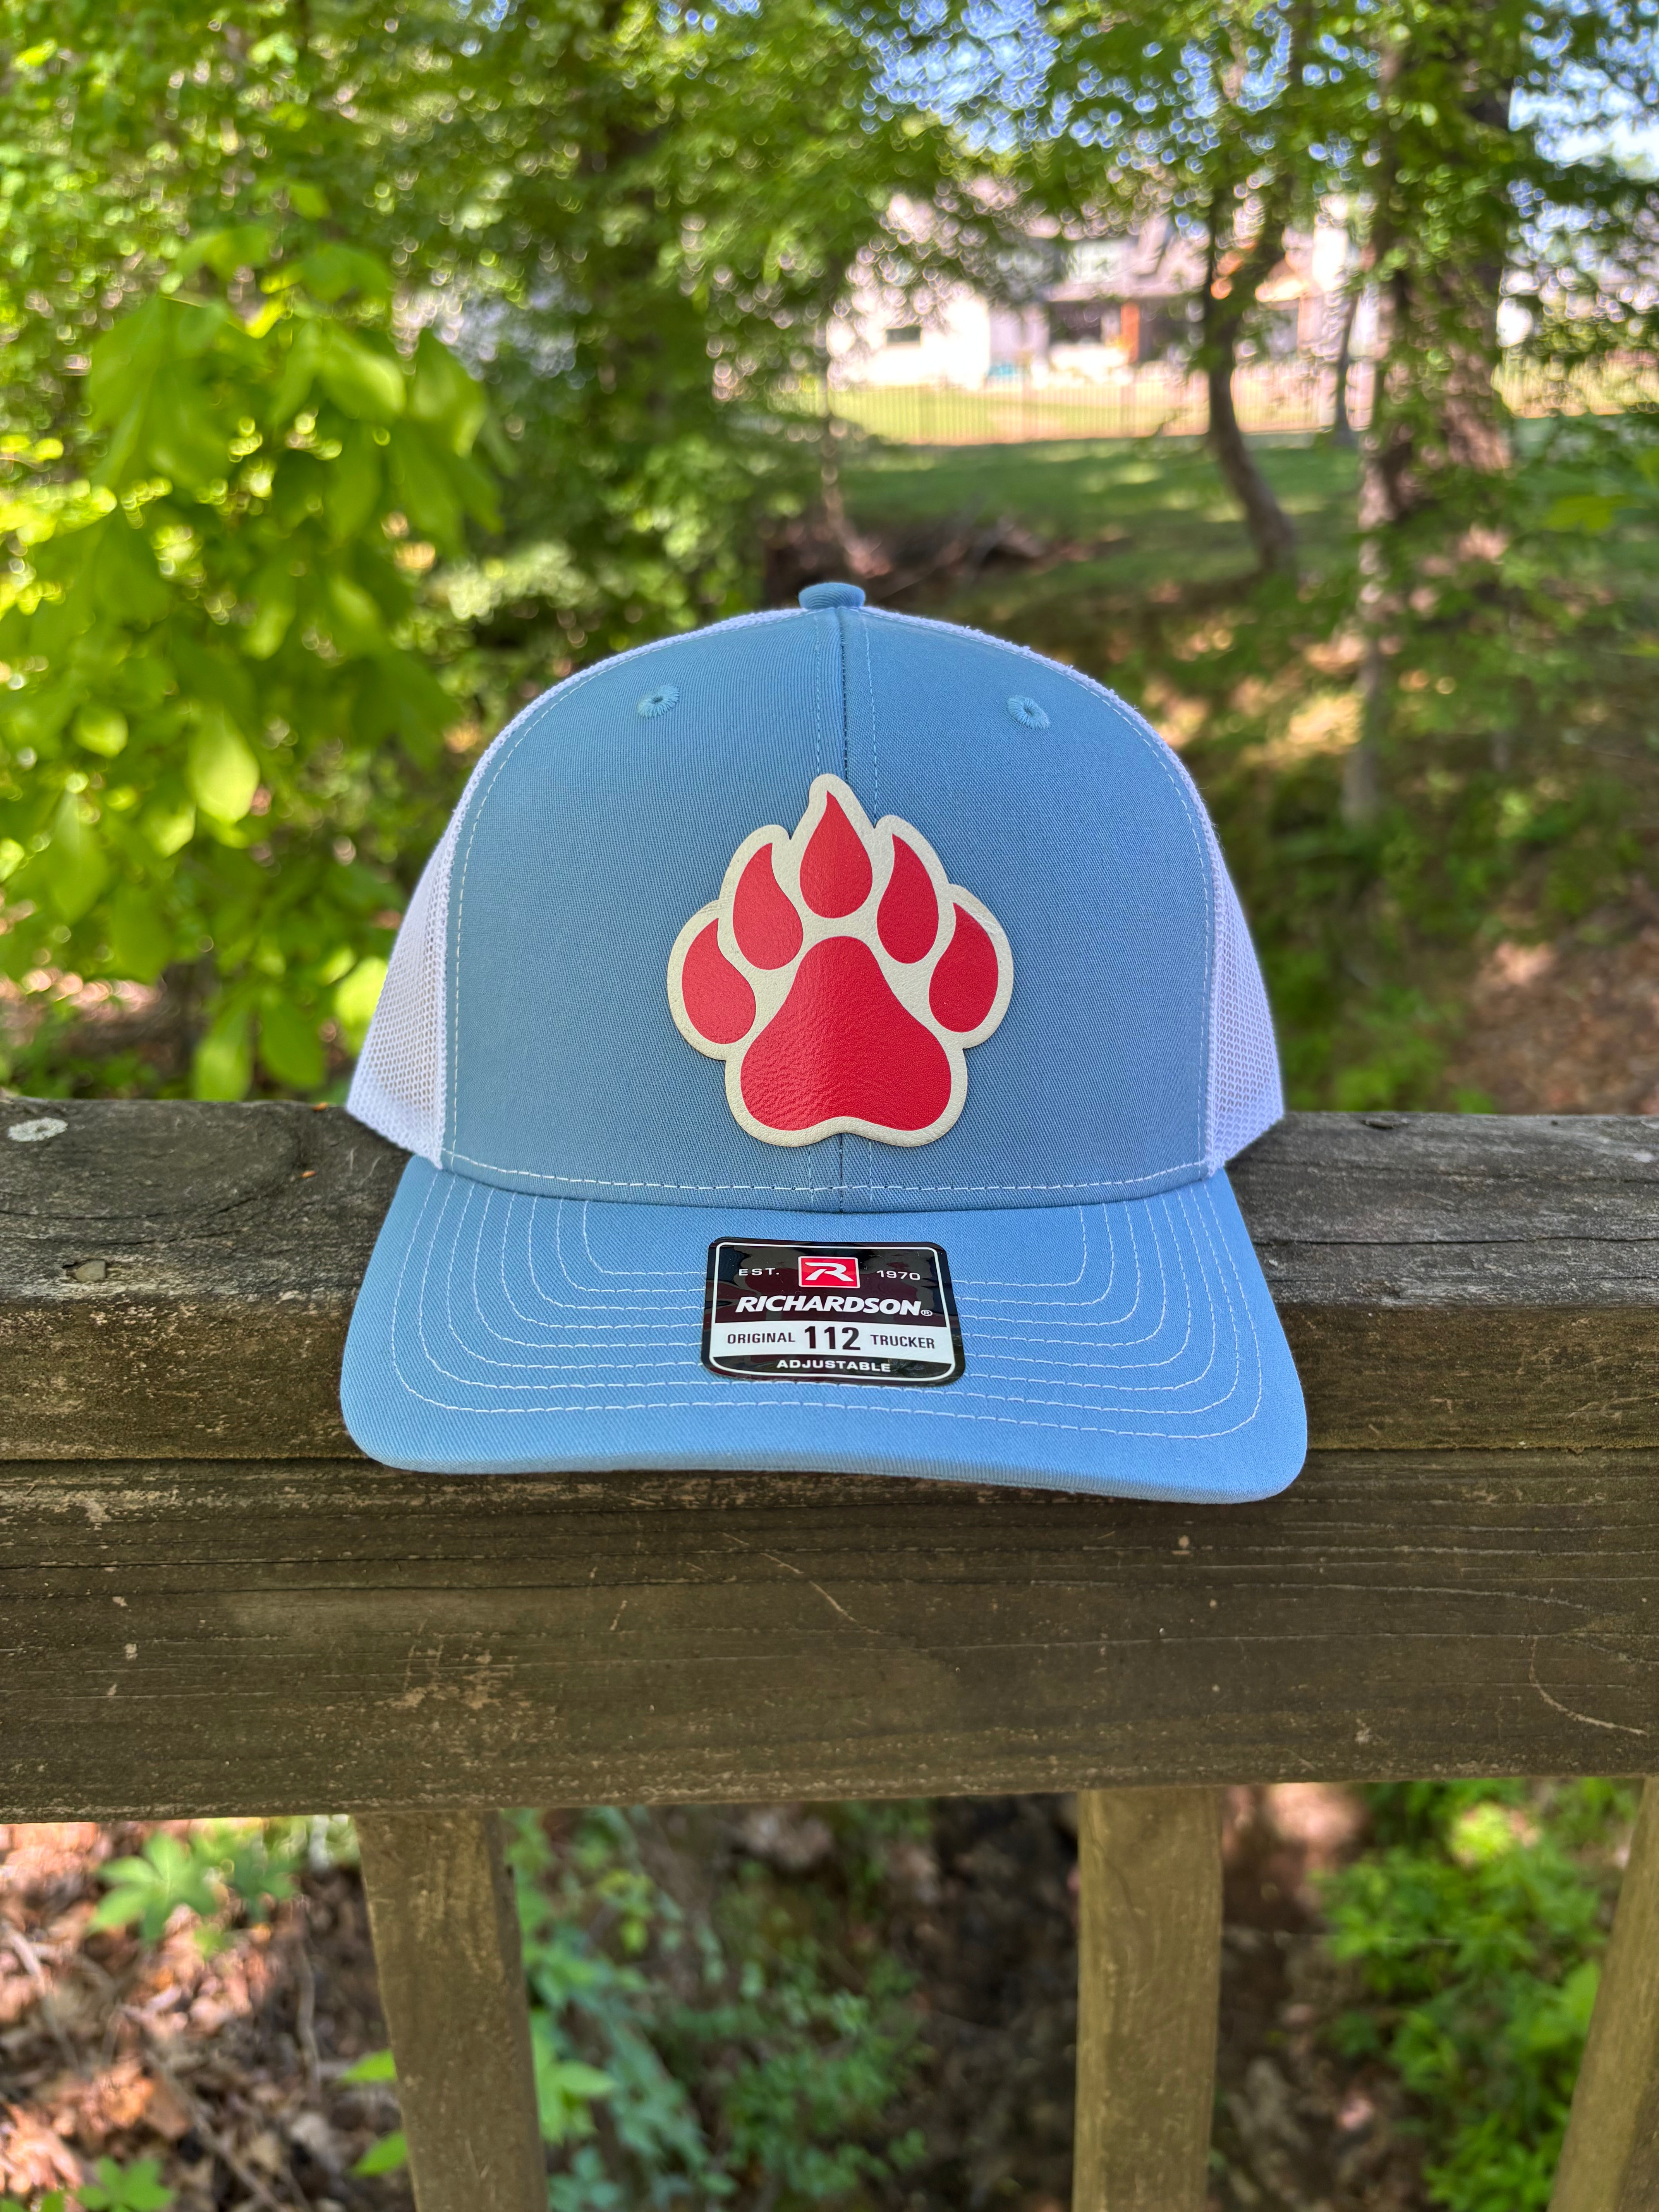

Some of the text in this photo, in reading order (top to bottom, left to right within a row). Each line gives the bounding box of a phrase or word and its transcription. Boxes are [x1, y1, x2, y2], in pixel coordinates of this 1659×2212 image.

[738, 1267, 779, 1276] EST.
[877, 1270, 921, 1280] 1970
[727, 1326, 934, 1350] ORIGINAL 112 TRUCKER
[776, 1359, 891, 1372] ADJUSTABLE
